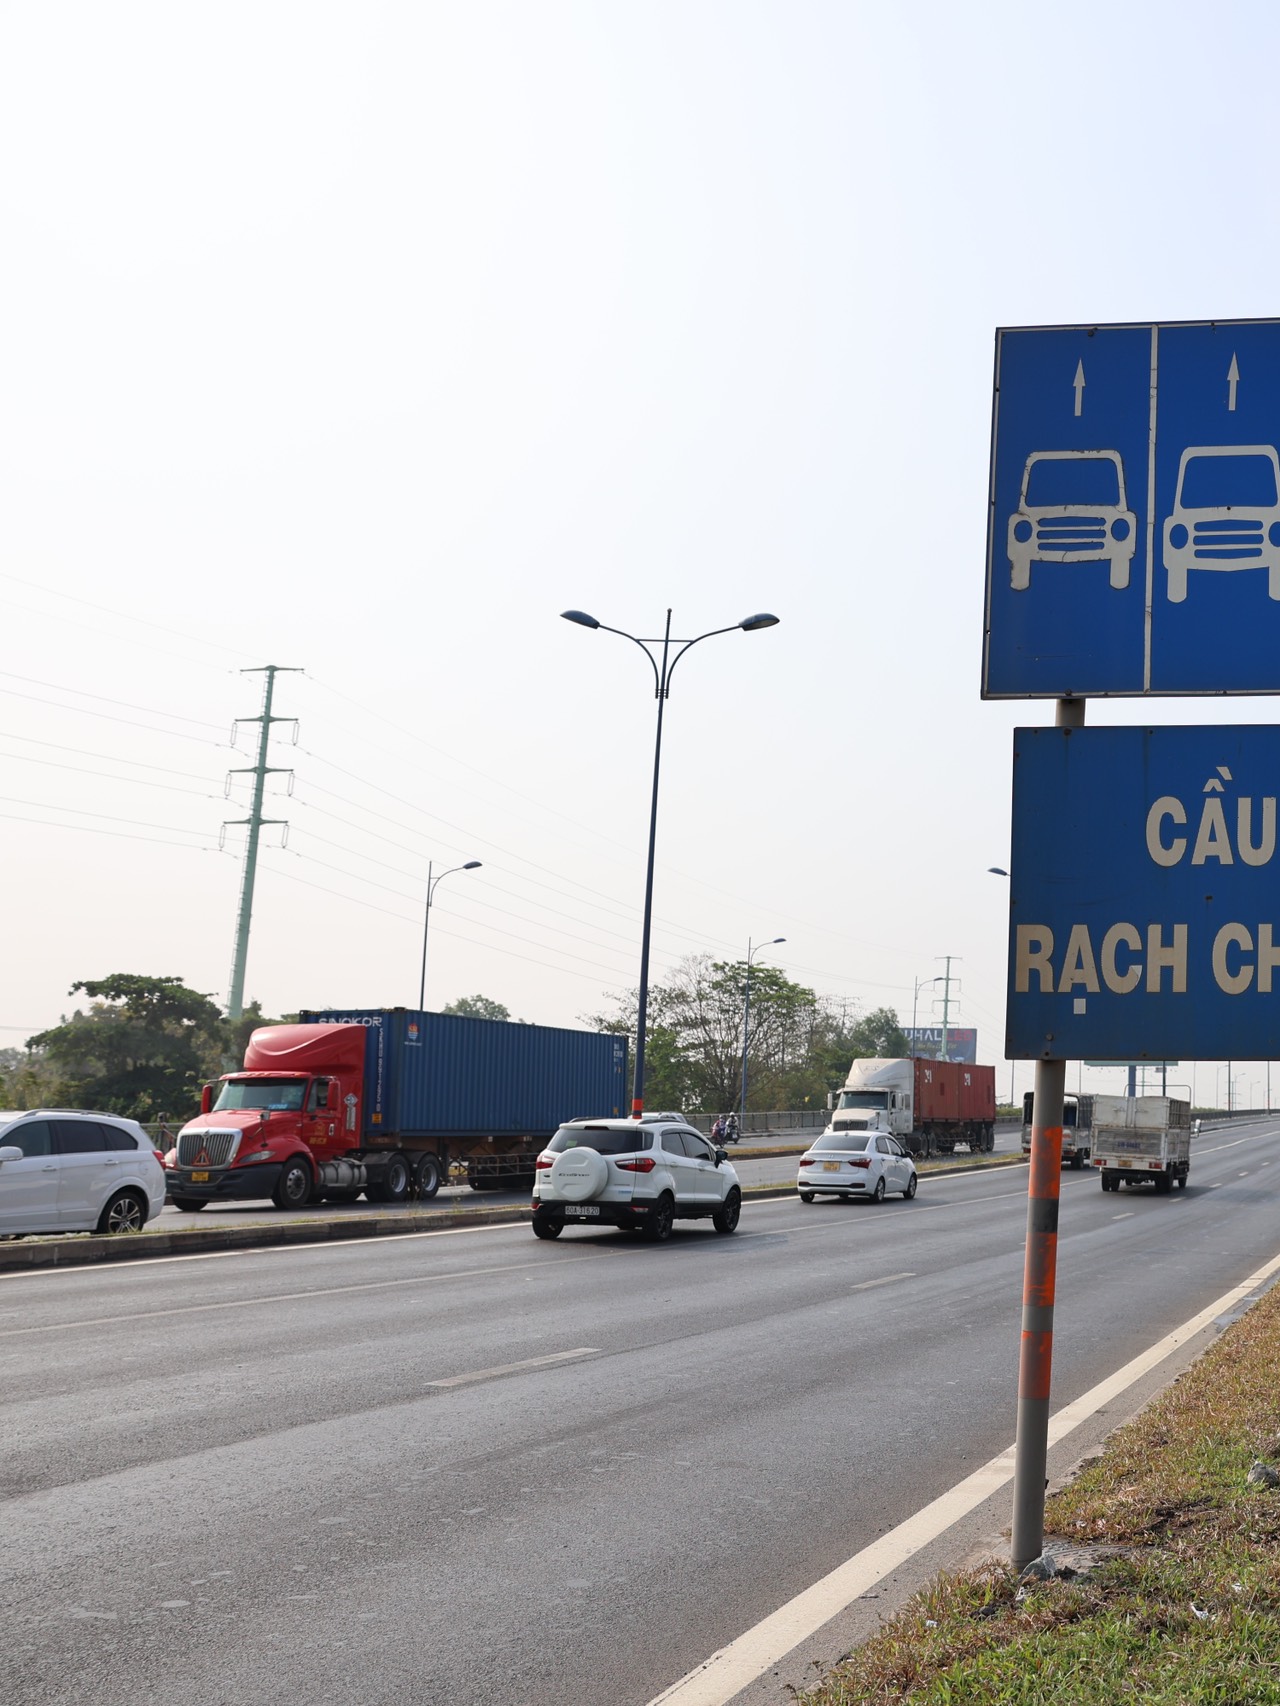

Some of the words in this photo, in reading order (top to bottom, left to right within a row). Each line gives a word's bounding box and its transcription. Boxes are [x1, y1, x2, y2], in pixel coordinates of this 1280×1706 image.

[1145, 766, 1277, 867] CẦU
[1015, 922, 1188, 1015] RẠCH
[898, 1029, 942, 1041] UHAL
